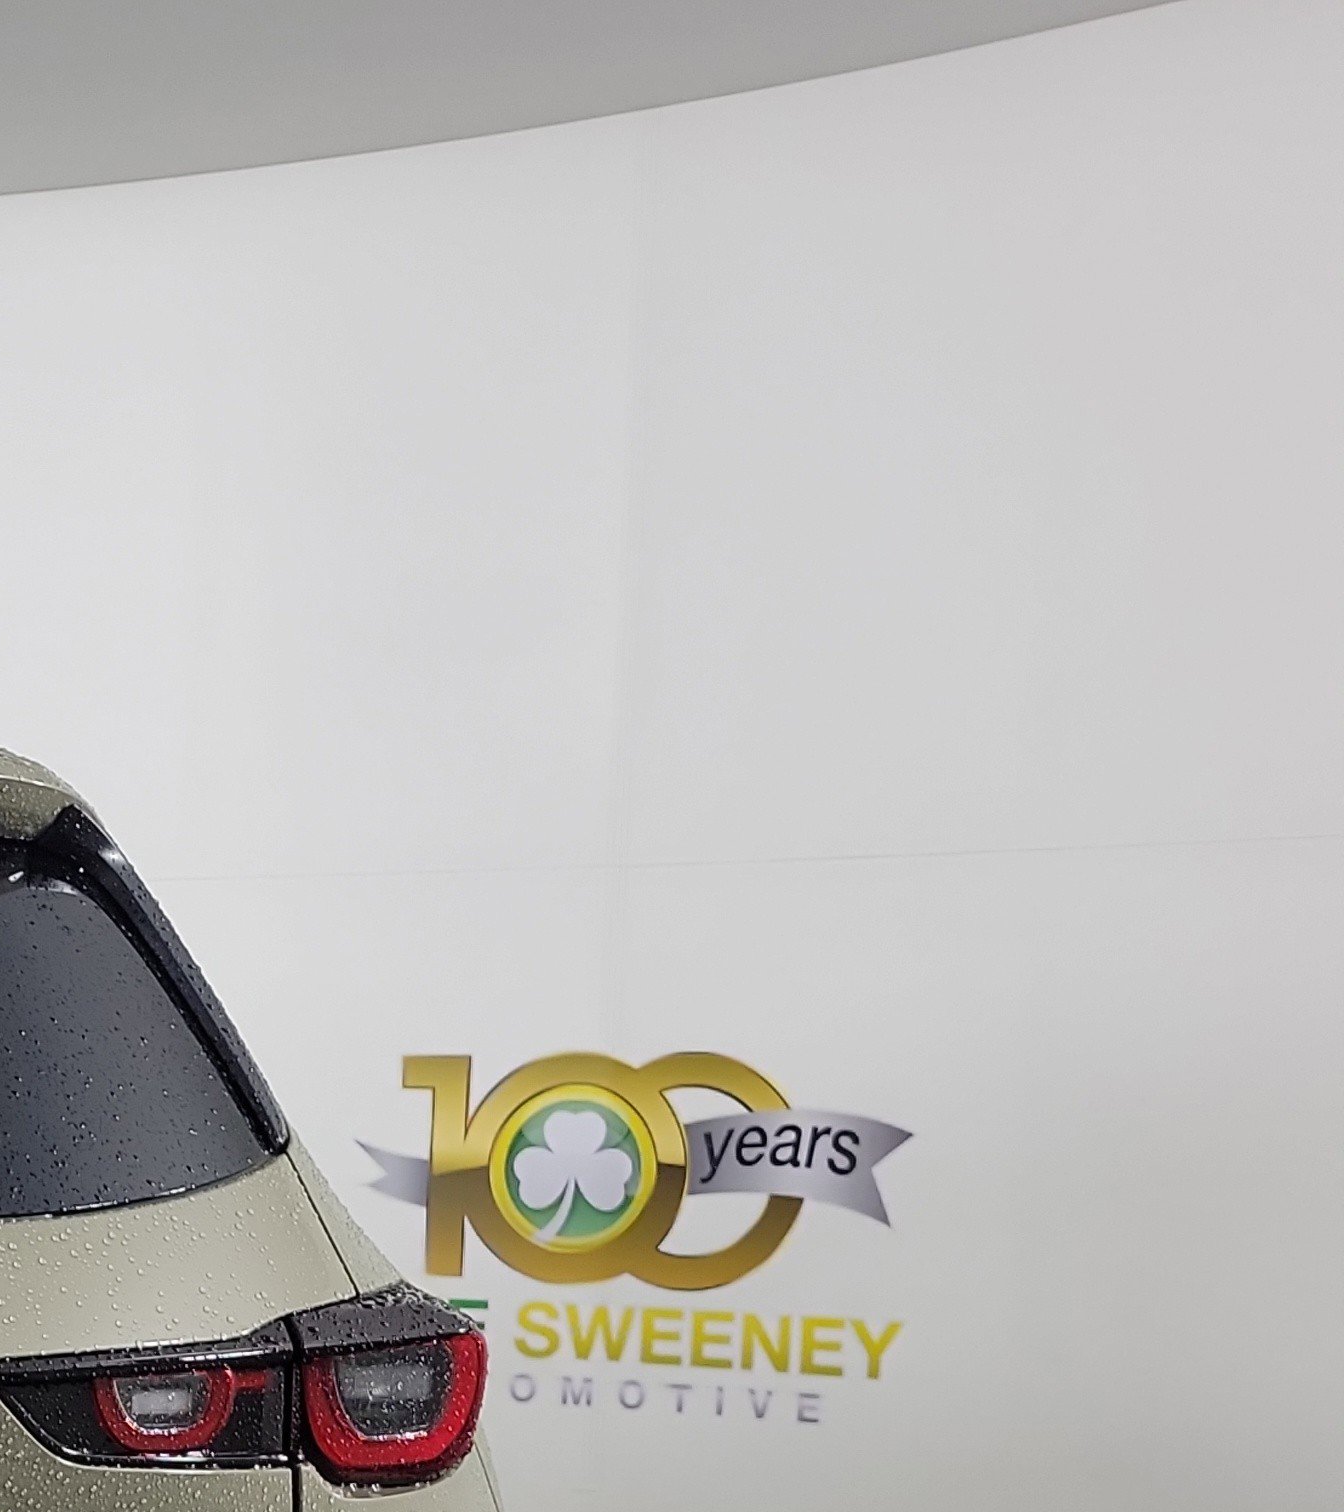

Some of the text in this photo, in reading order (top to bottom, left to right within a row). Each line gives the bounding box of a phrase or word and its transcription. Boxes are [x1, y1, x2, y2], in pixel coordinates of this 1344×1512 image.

[401, 1051, 805, 1291] 100
[698, 1121, 862, 1185] years
[513, 1301, 905, 1381] SWEENEY
[509, 1373, 822, 1424] OMOTIVE
